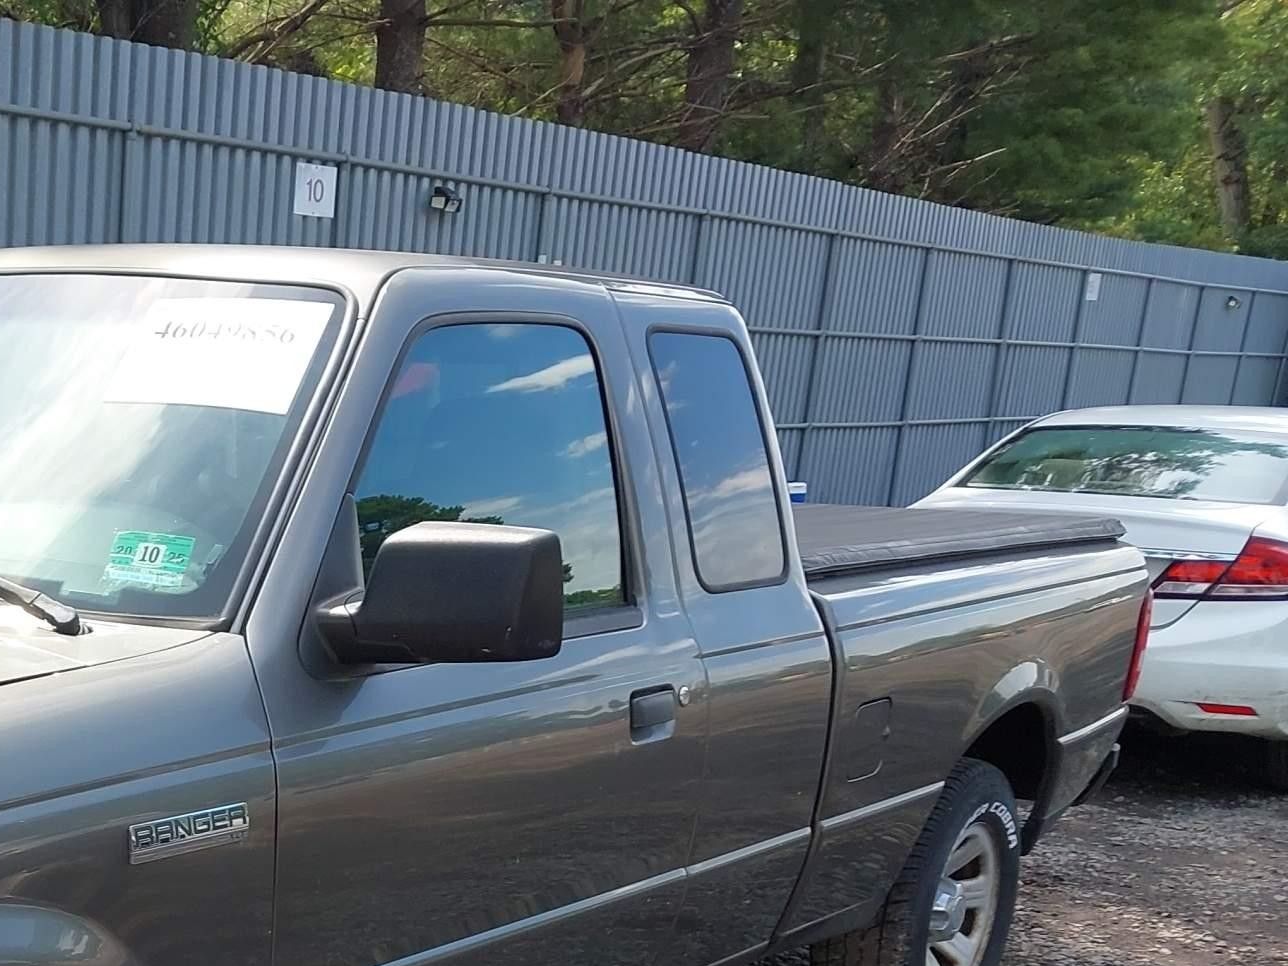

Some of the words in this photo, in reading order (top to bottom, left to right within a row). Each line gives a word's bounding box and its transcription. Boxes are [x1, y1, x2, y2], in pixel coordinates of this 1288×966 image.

[306, 178, 324, 202] 10
[138, 545, 161, 564] 10
[134, 804, 249, 849] RANGER
[989, 801, 1018, 849] COBRA
